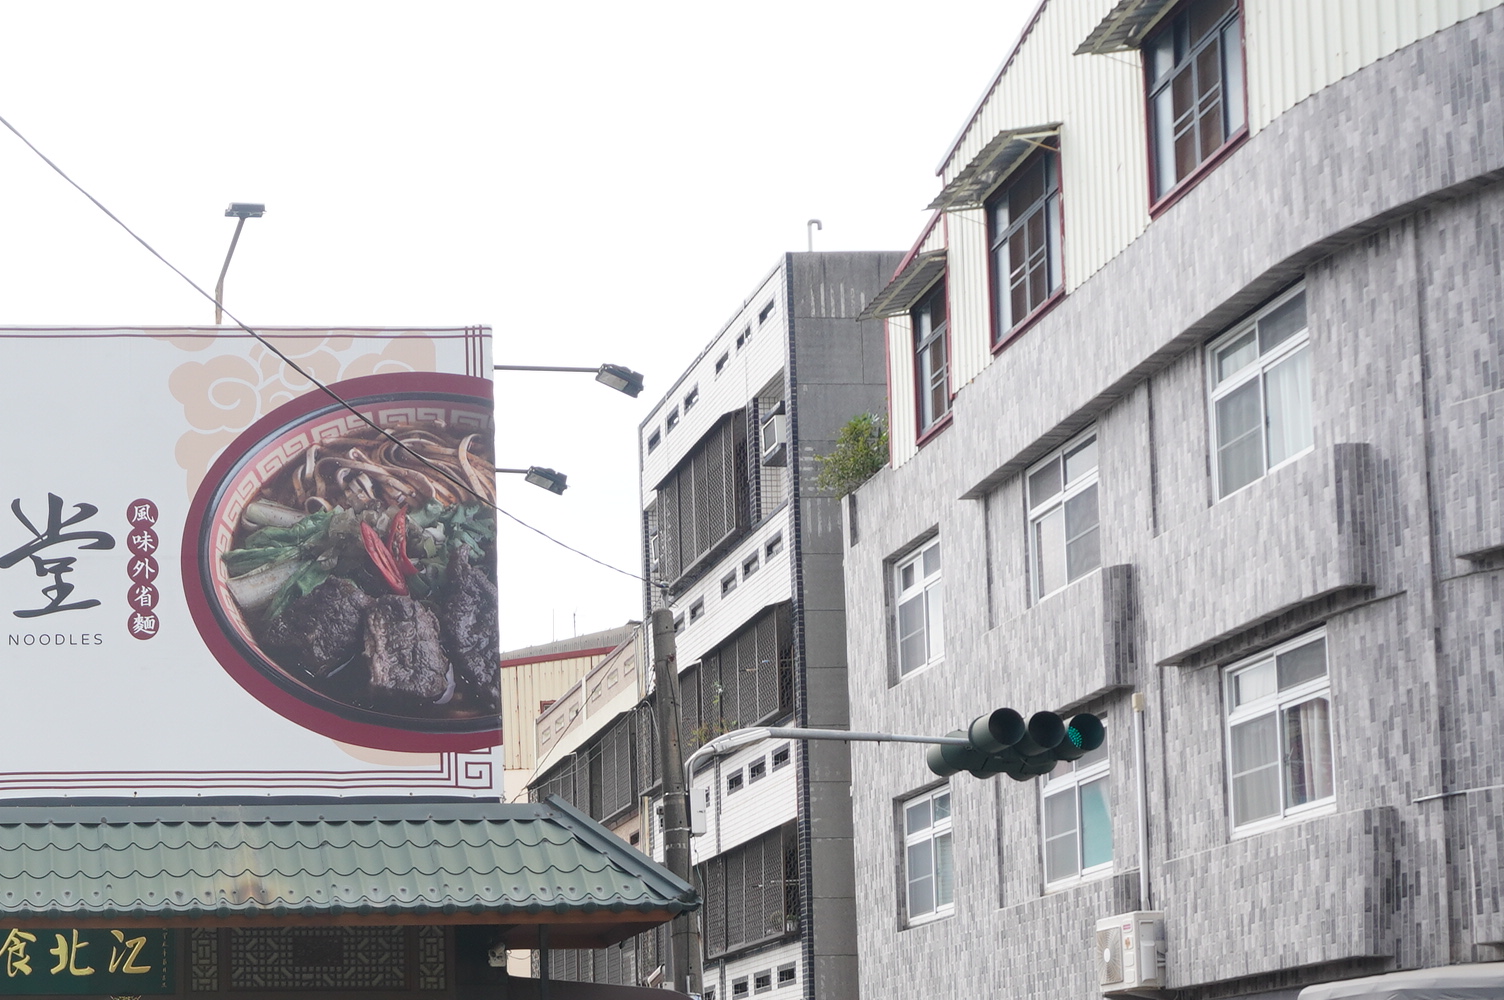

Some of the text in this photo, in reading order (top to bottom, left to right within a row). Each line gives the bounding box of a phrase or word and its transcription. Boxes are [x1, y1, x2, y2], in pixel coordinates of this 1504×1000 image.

[131, 503, 156, 635] 風味外省麵
[8, 633, 103, 646] NOODLES
